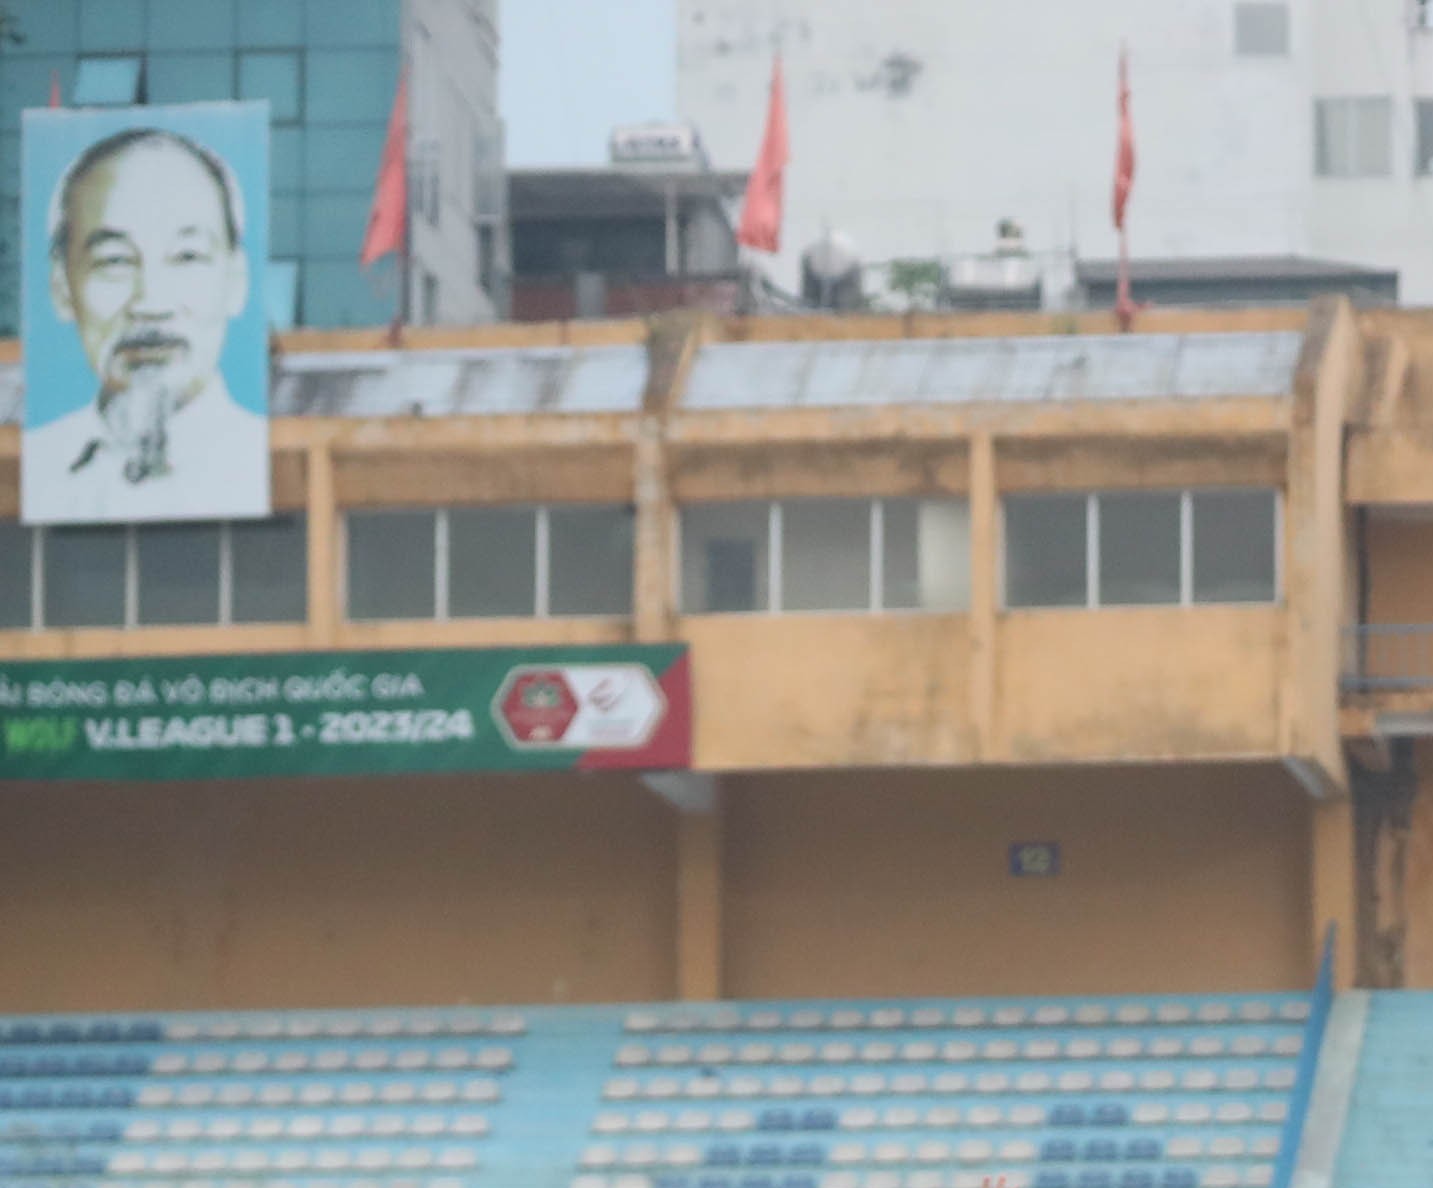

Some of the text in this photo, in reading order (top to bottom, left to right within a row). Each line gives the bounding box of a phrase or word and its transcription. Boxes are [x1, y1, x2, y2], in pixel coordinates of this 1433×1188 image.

[85, 713, 267, 749] V.LEAGUE
[273, 713, 295, 747] 1
[319, 708, 475, 744] 2023/24
